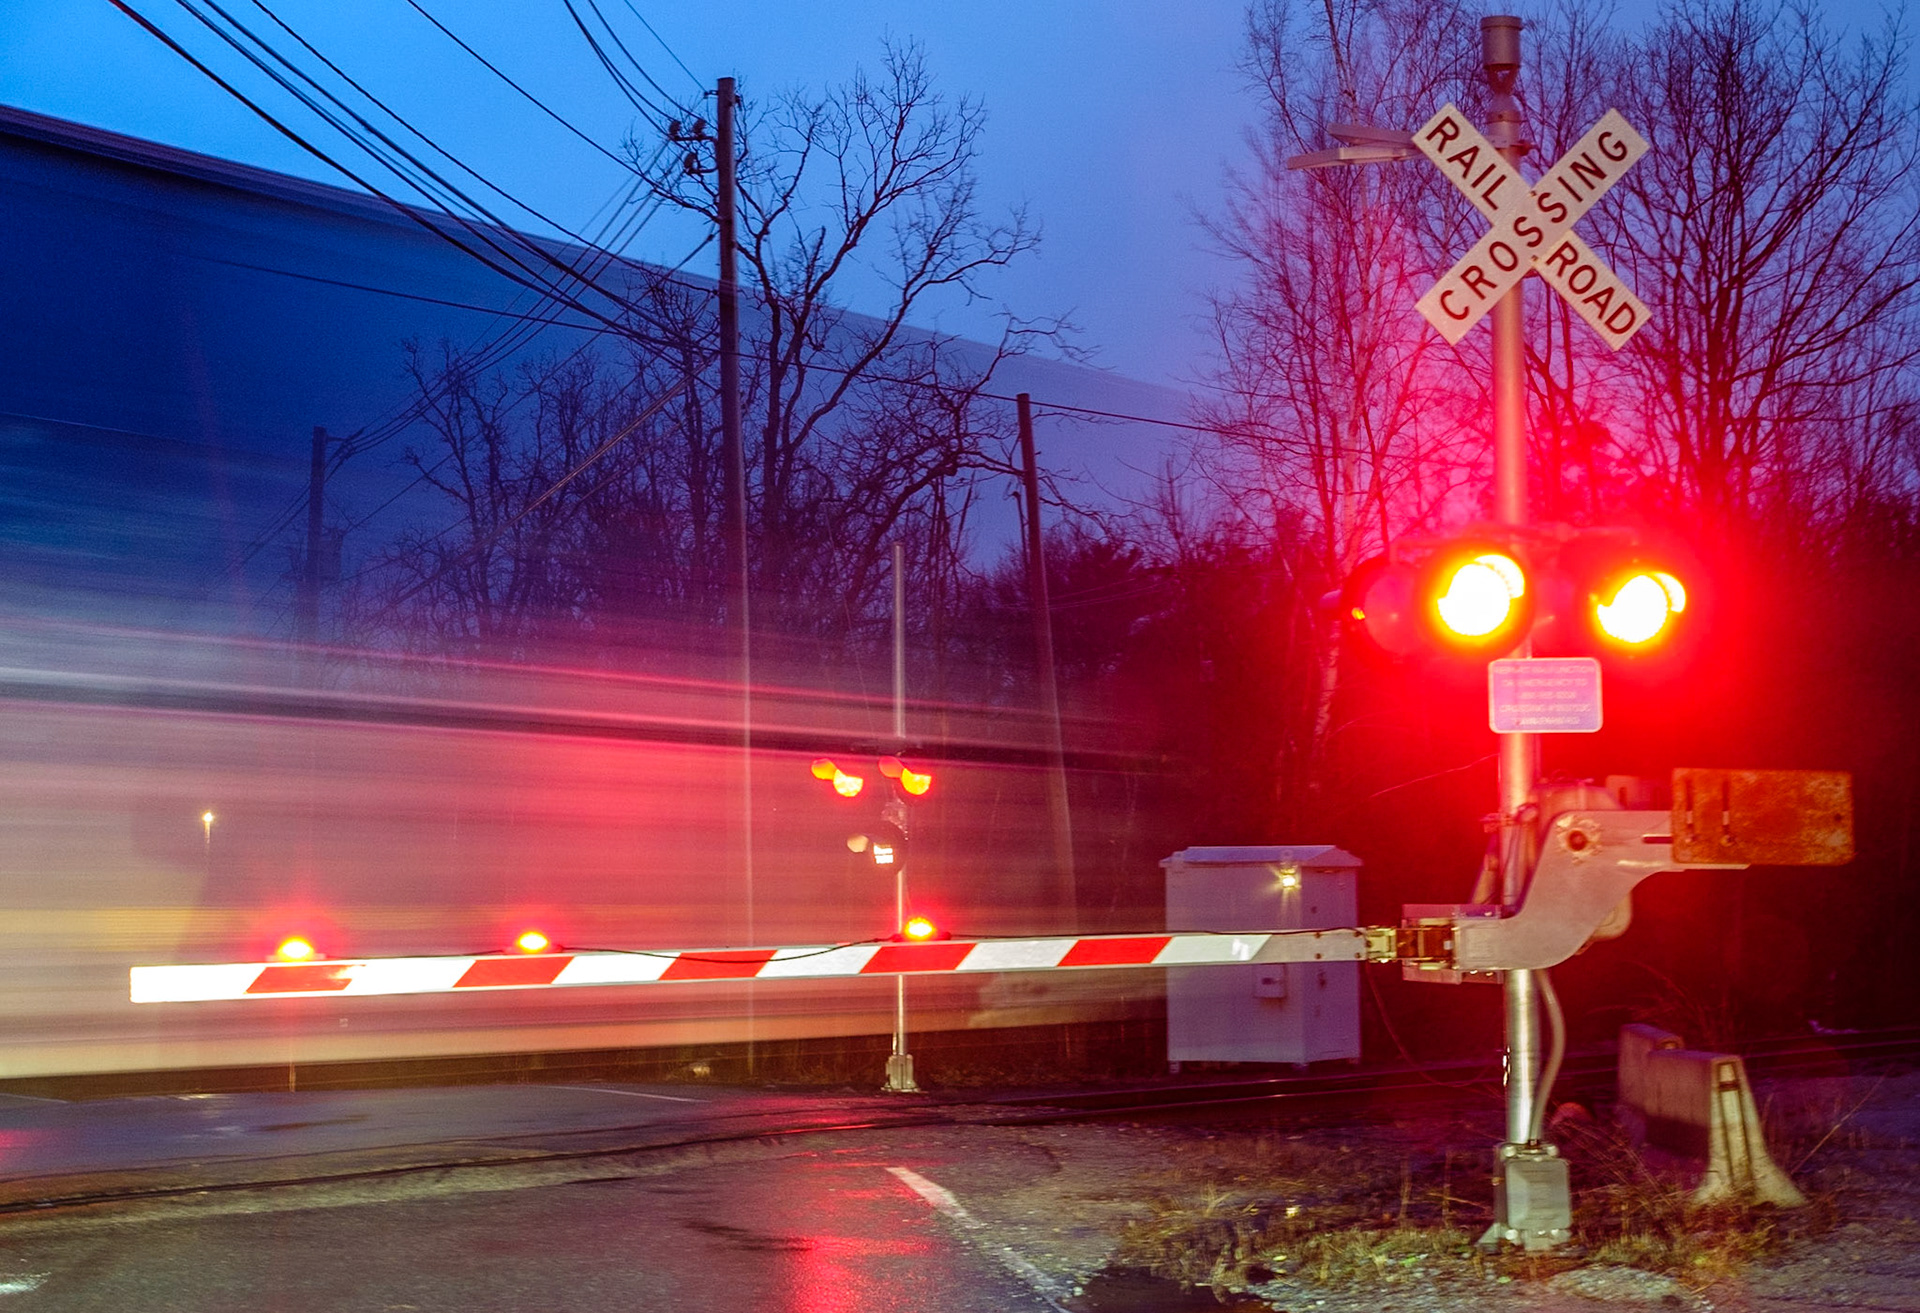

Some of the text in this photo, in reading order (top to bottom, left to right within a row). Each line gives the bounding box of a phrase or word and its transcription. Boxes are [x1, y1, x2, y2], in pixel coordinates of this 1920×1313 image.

[1426, 116, 1636, 334] RAIL ROAD
[1440, 131, 1628, 320] CROSSING
